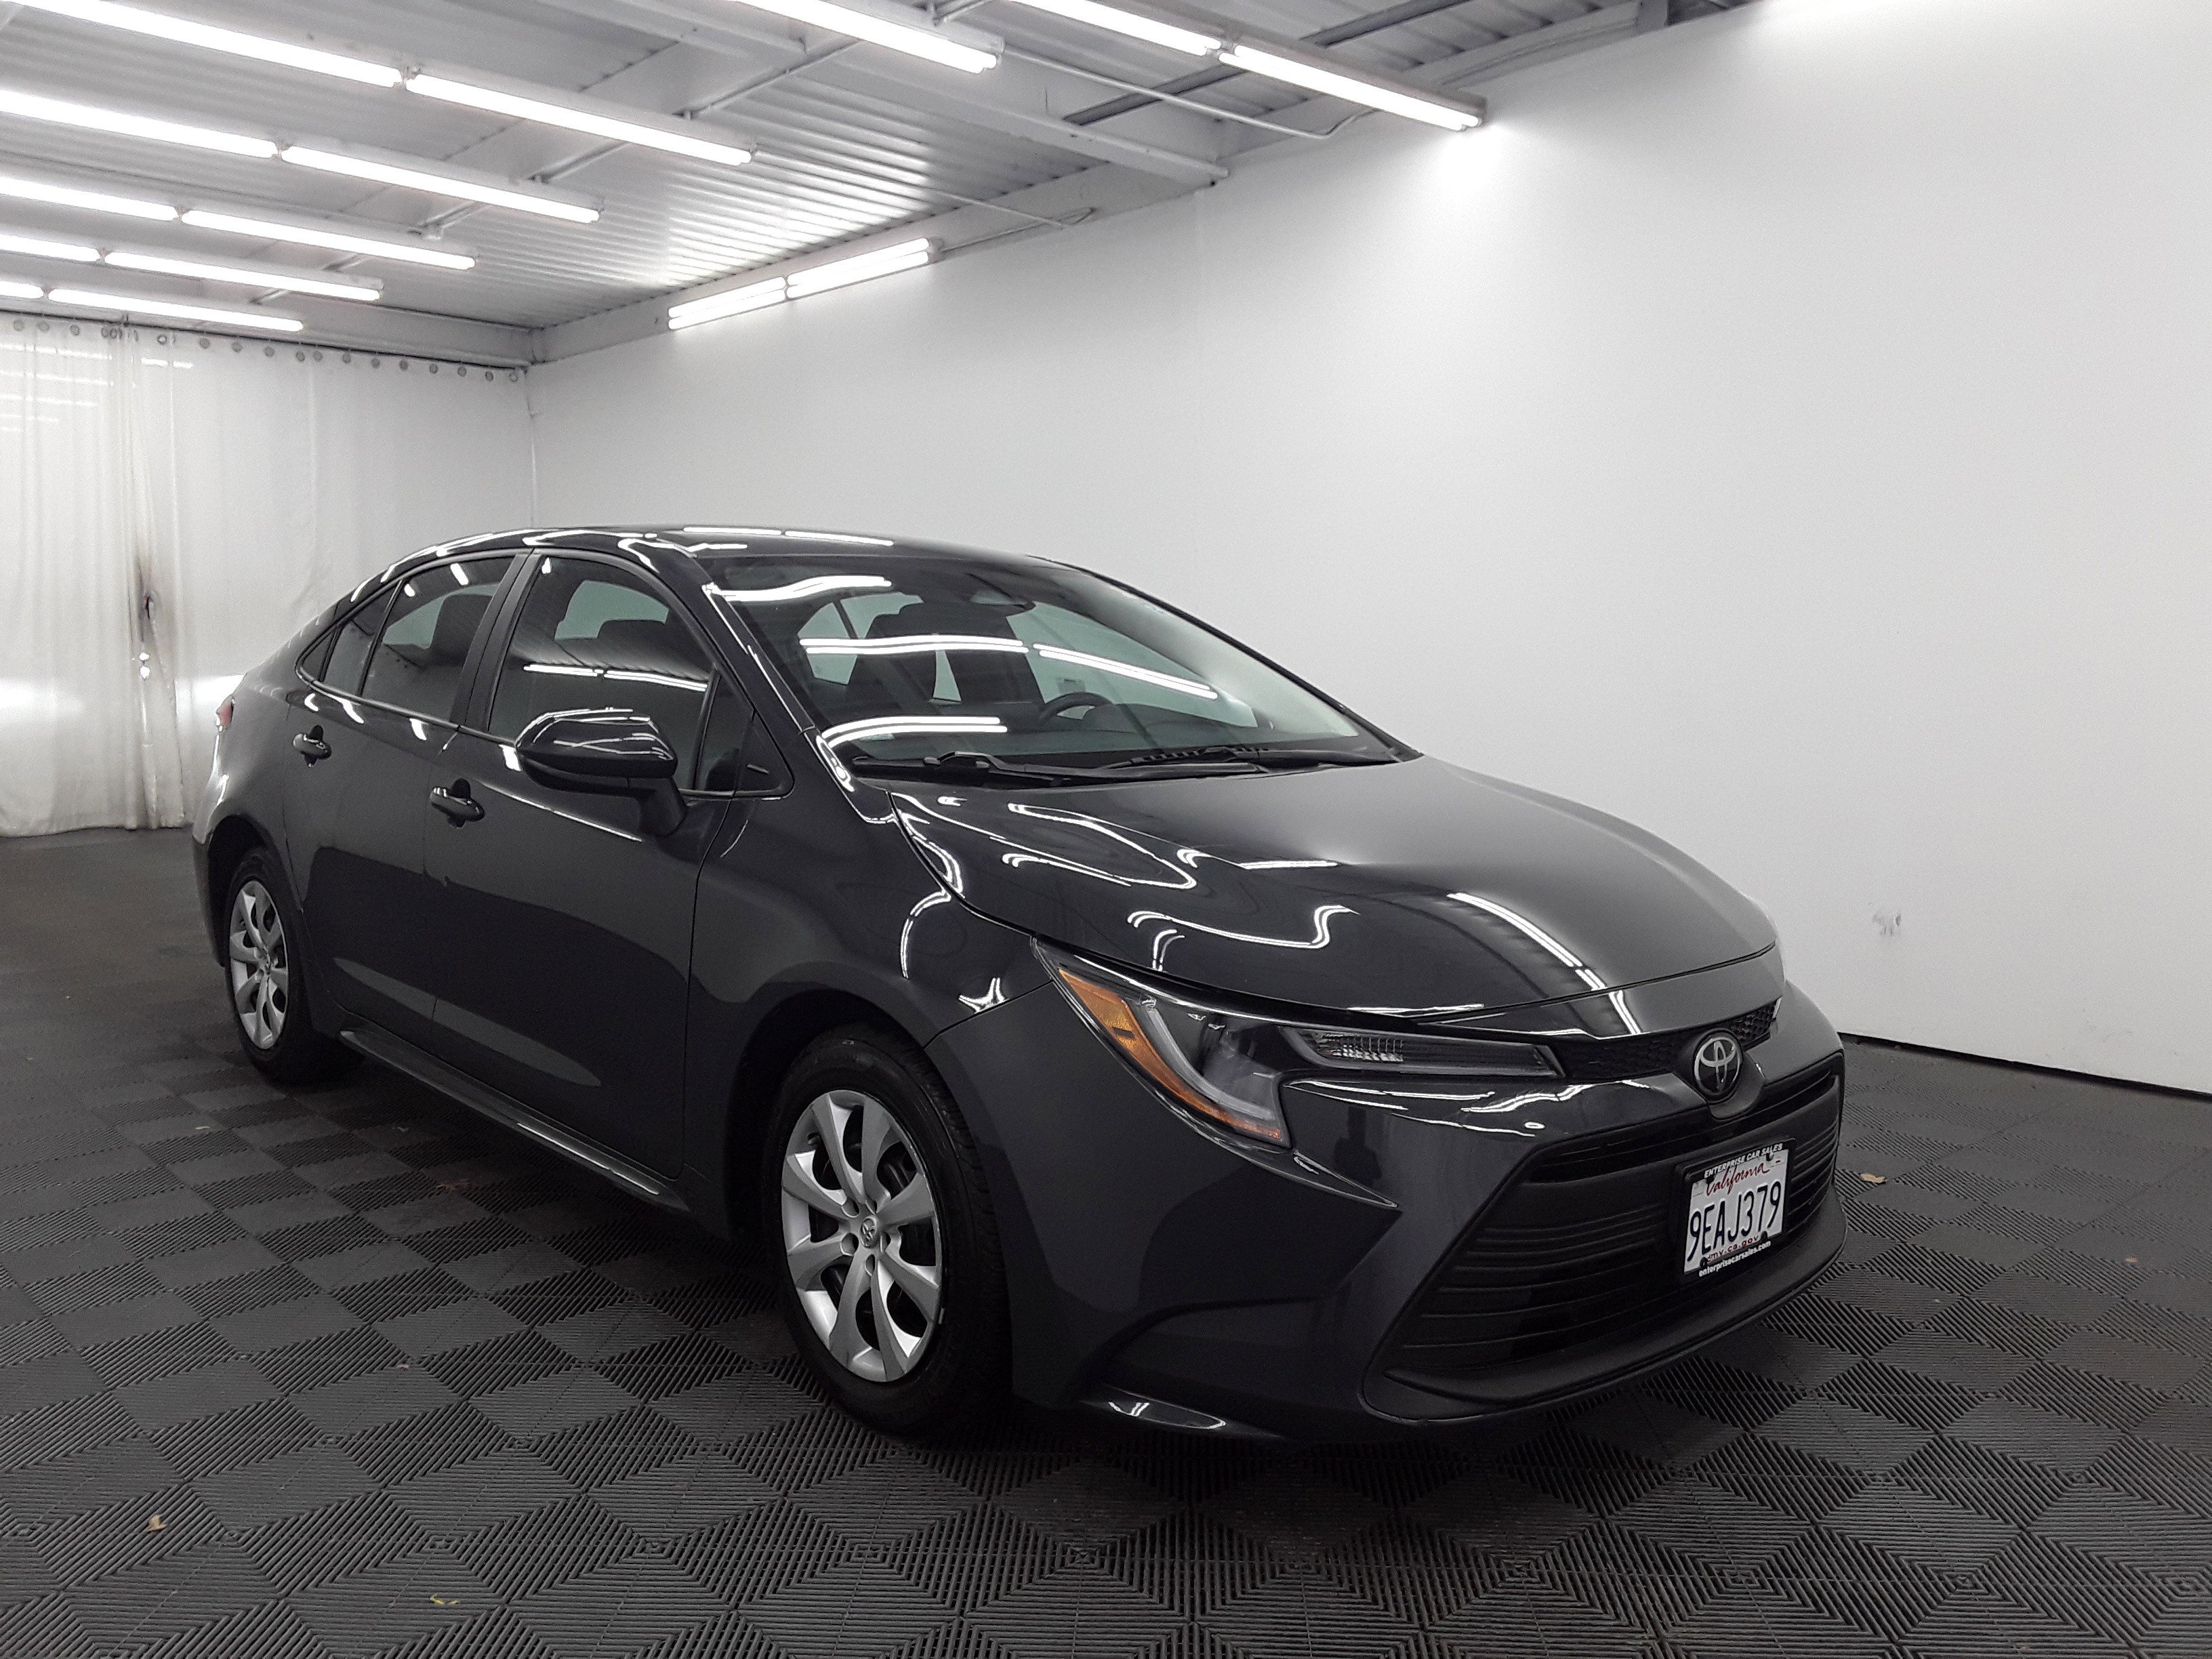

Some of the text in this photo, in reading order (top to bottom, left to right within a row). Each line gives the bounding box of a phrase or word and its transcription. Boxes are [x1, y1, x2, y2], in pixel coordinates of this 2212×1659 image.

[1704, 1143, 1783, 1179] ENTERPRISE CAR SALES
[1687, 1181, 1782, 1262] 9EAJ379
